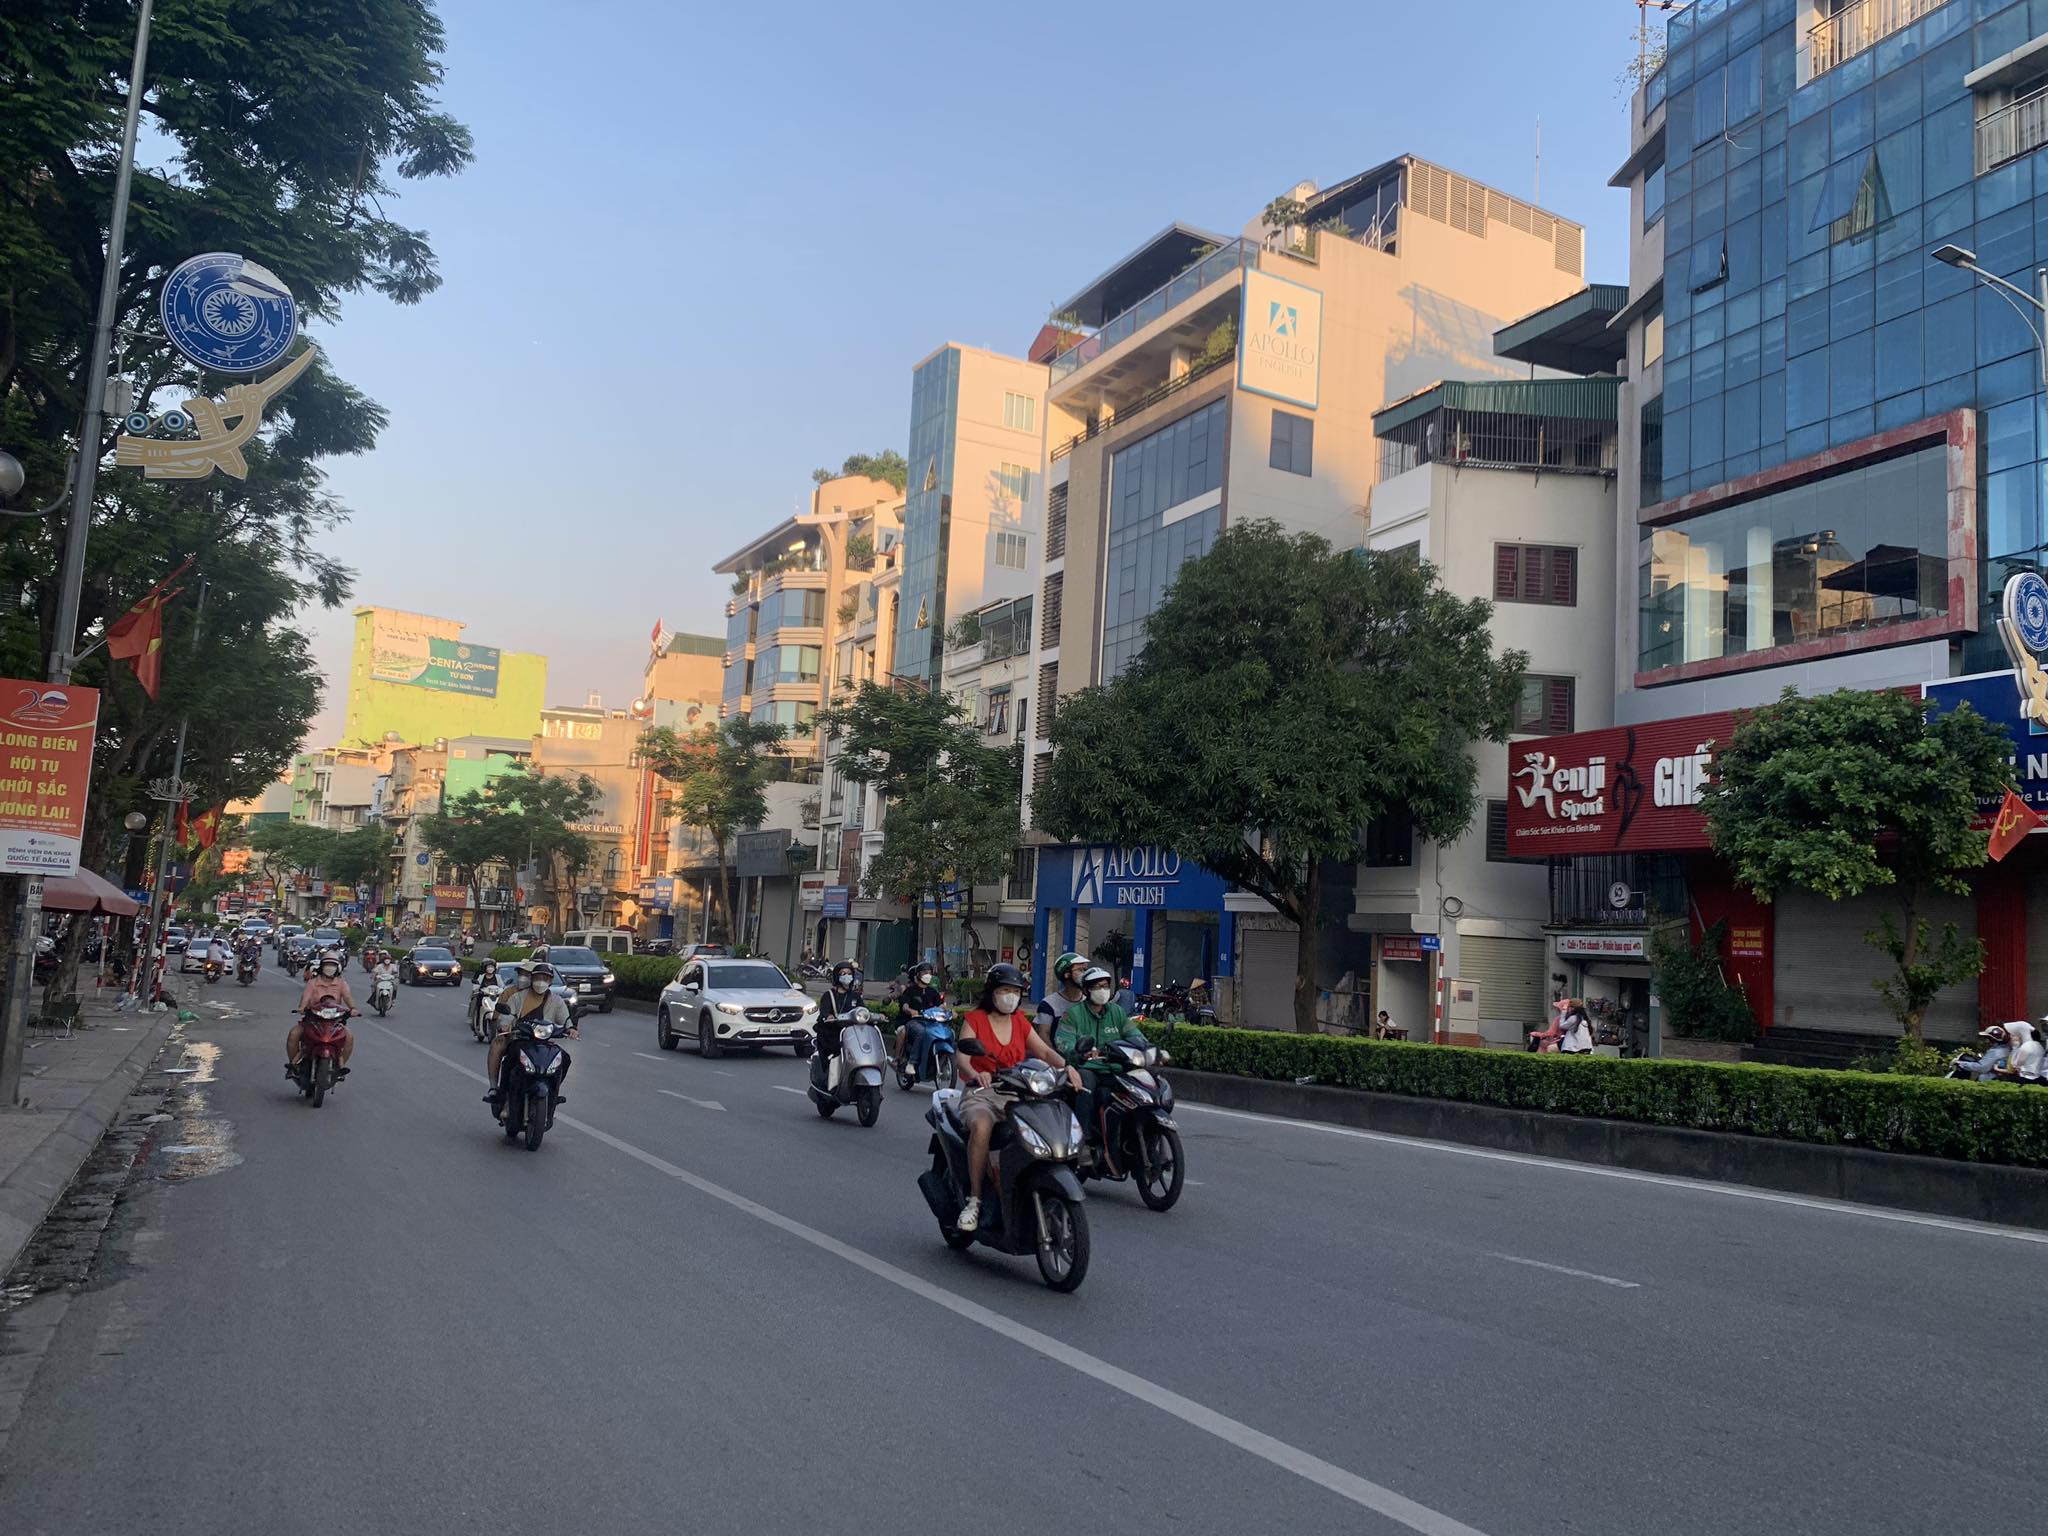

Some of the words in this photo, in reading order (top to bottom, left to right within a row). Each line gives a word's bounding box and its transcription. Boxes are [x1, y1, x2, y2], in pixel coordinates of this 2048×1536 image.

[1249, 332, 1314, 364] APOLLO
[428, 656, 463, 670] CENTA
[0, 732, 37, 748] LONG
[41, 735, 77, 752] BIÊN
[10, 755, 36, 773] HỘI
[41, 759, 60, 776] TỤ
[0, 775, 32, 793] KHỞI
[36, 778, 67, 796] SẮC
[0, 801, 37, 817] ƯƠNG
[41, 805, 71, 819] LAI!
[1560, 797, 1605, 821] Sport
[602, 824, 623, 834] HOTEL
[1589, 823, 1601, 832] Bạn
[7, 854, 30, 862] QUỐC
[1105, 845, 1180, 877] APOLLO
[452, 891, 466, 900] BẠC
[1118, 886, 1165, 905] ENGLISH
